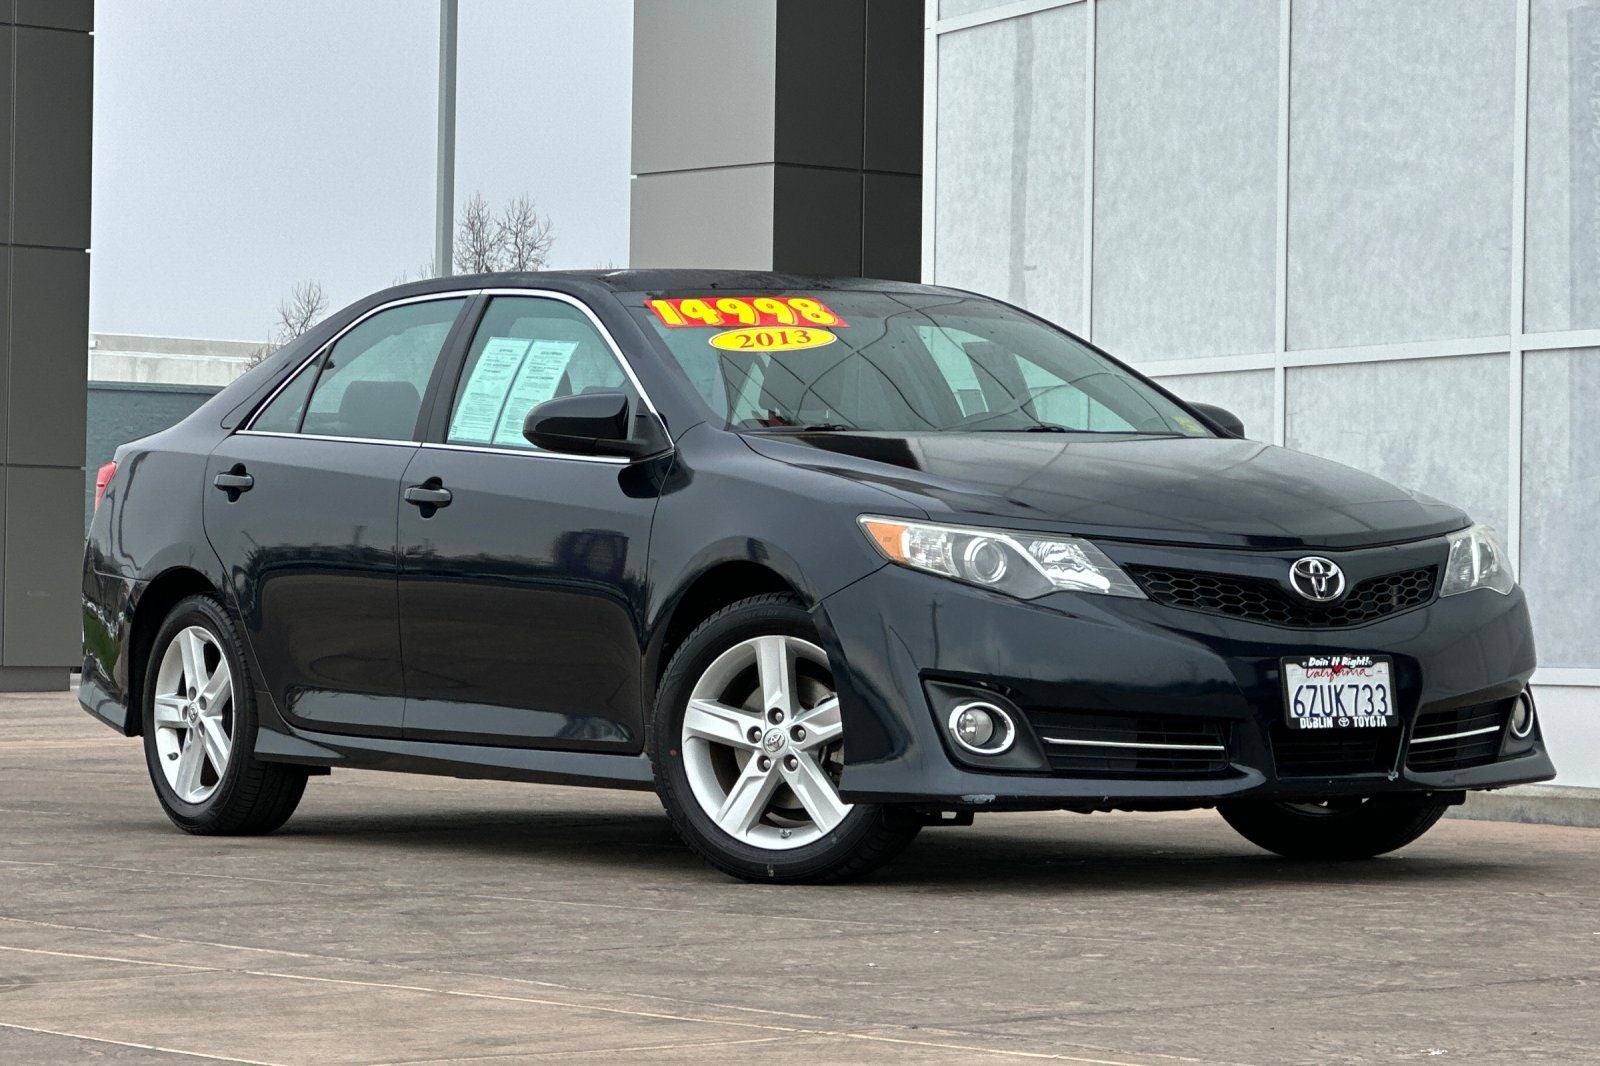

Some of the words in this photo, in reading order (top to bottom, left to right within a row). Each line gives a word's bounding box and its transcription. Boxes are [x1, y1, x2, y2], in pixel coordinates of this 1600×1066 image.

[652, 297, 838, 325] 14998
[736, 330, 812, 349] 2013
[1308, 656, 1331, 666] Doin'
[1331, 656, 1341, 666] It
[1341, 656, 1370, 668] Right!
[1293, 684, 1388, 717] 6ZUK733
[1299, 716, 1333, 729] DUBLIN
[1353, 715, 1387, 728] TOYOTA
